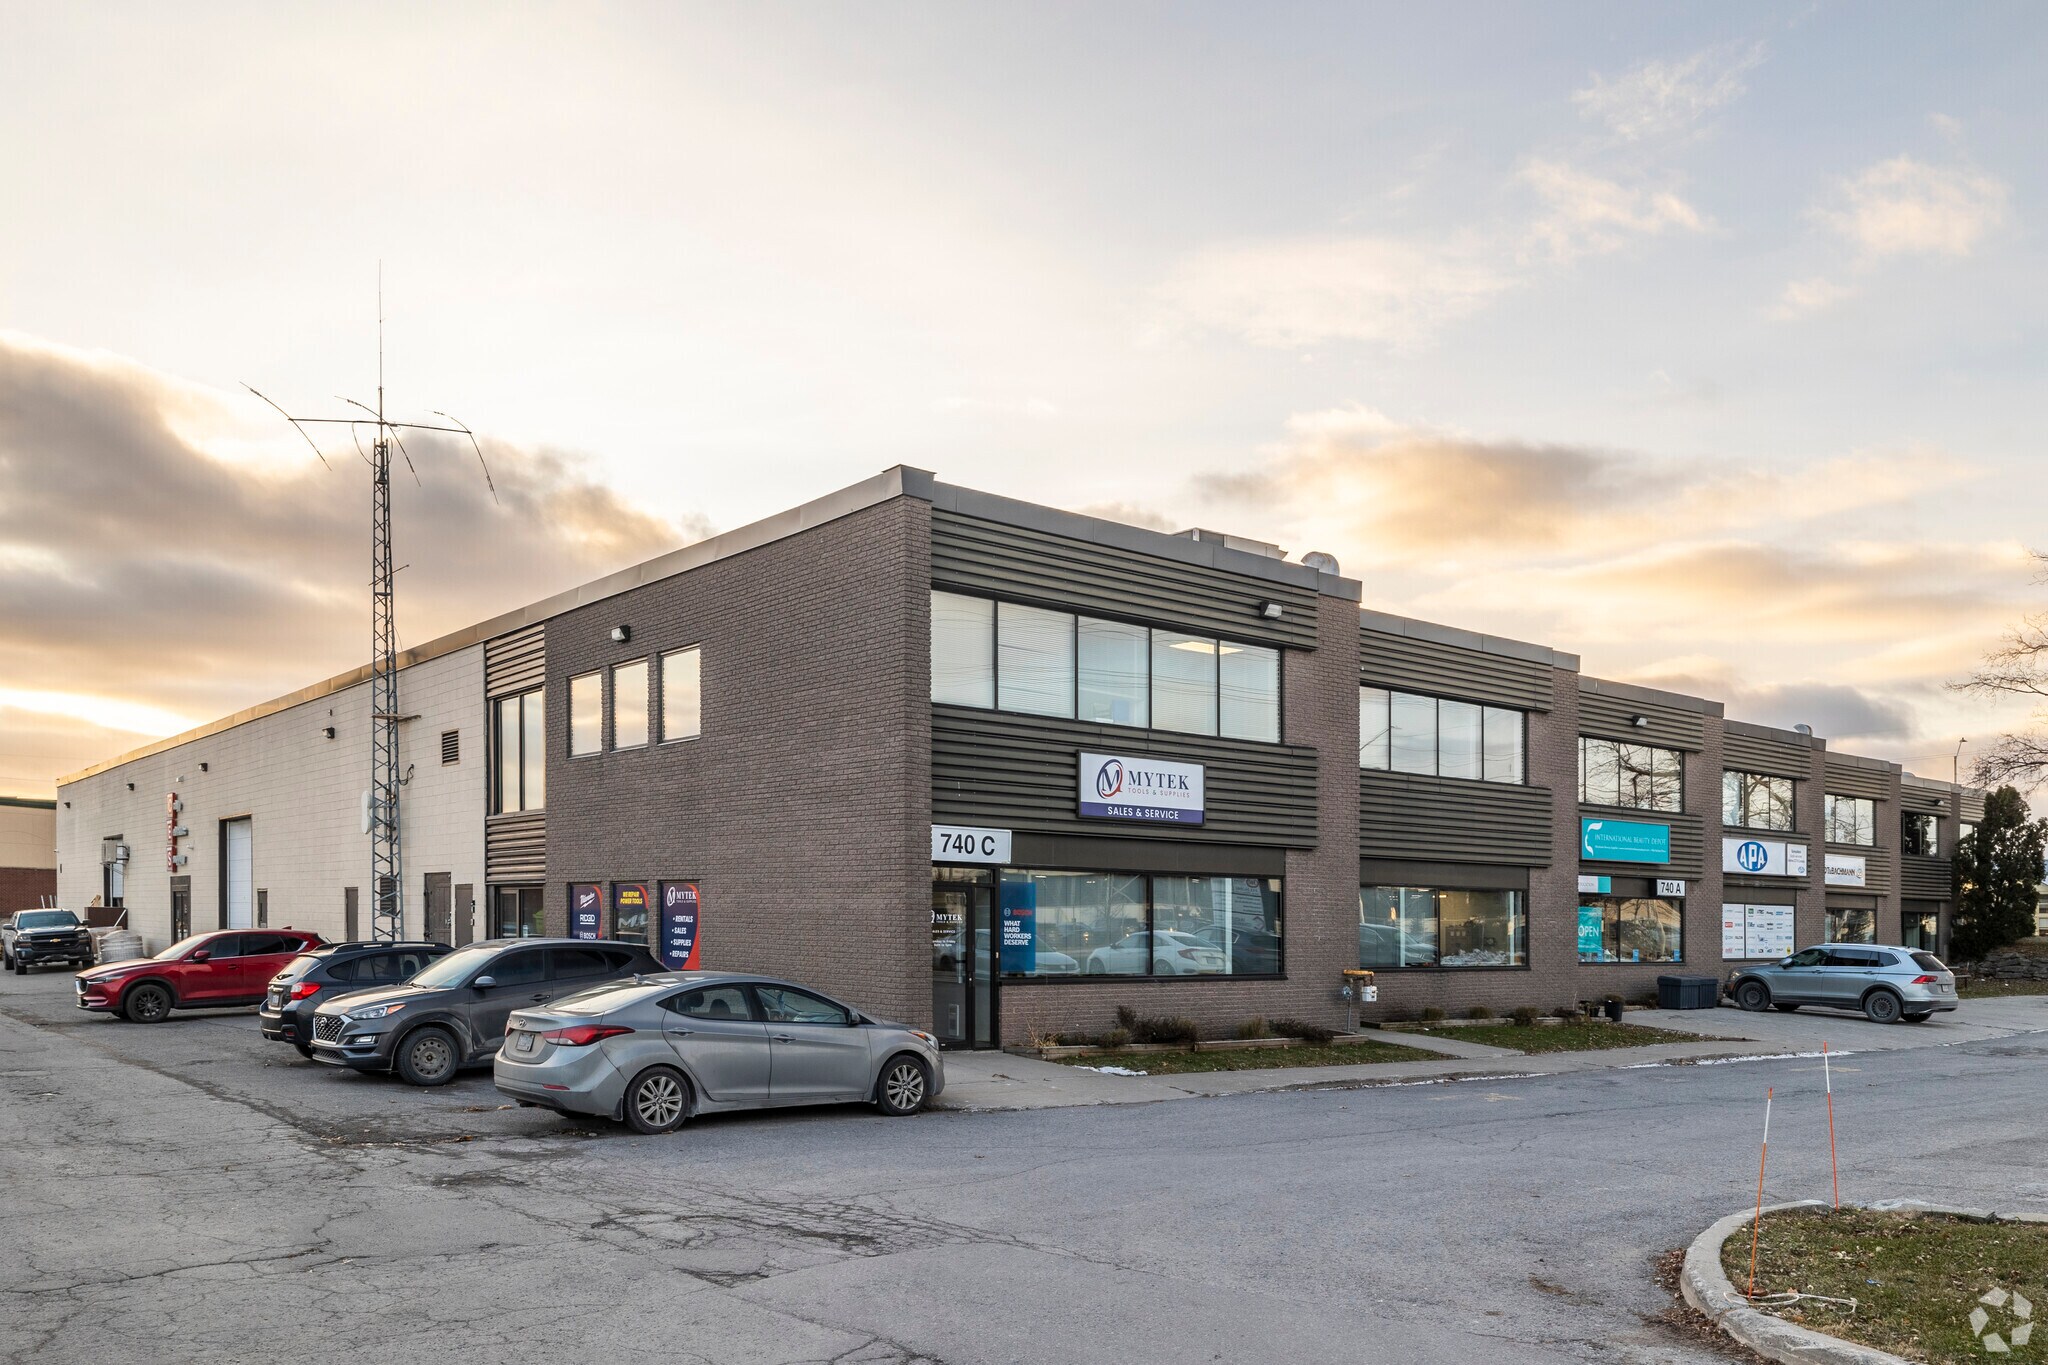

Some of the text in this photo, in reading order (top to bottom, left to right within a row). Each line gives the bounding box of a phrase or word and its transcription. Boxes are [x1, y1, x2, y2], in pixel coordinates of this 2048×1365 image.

[1128, 770, 1189, 790] MYTEK
[1128, 787, 1149, 795] TOOLS
[1160, 790, 1190, 798] SUPPLIES
[1108, 806, 1178, 820] SALES & SERVICE
[940, 833, 995, 856] 740 C
[1594, 834, 1632, 843] INTERNATIONAL
[1740, 844, 1766, 870] APA
[1660, 882, 1681, 894] 740 A
[676, 891, 696, 899] MYTEK
[1578, 925, 1599, 937] OPEN
